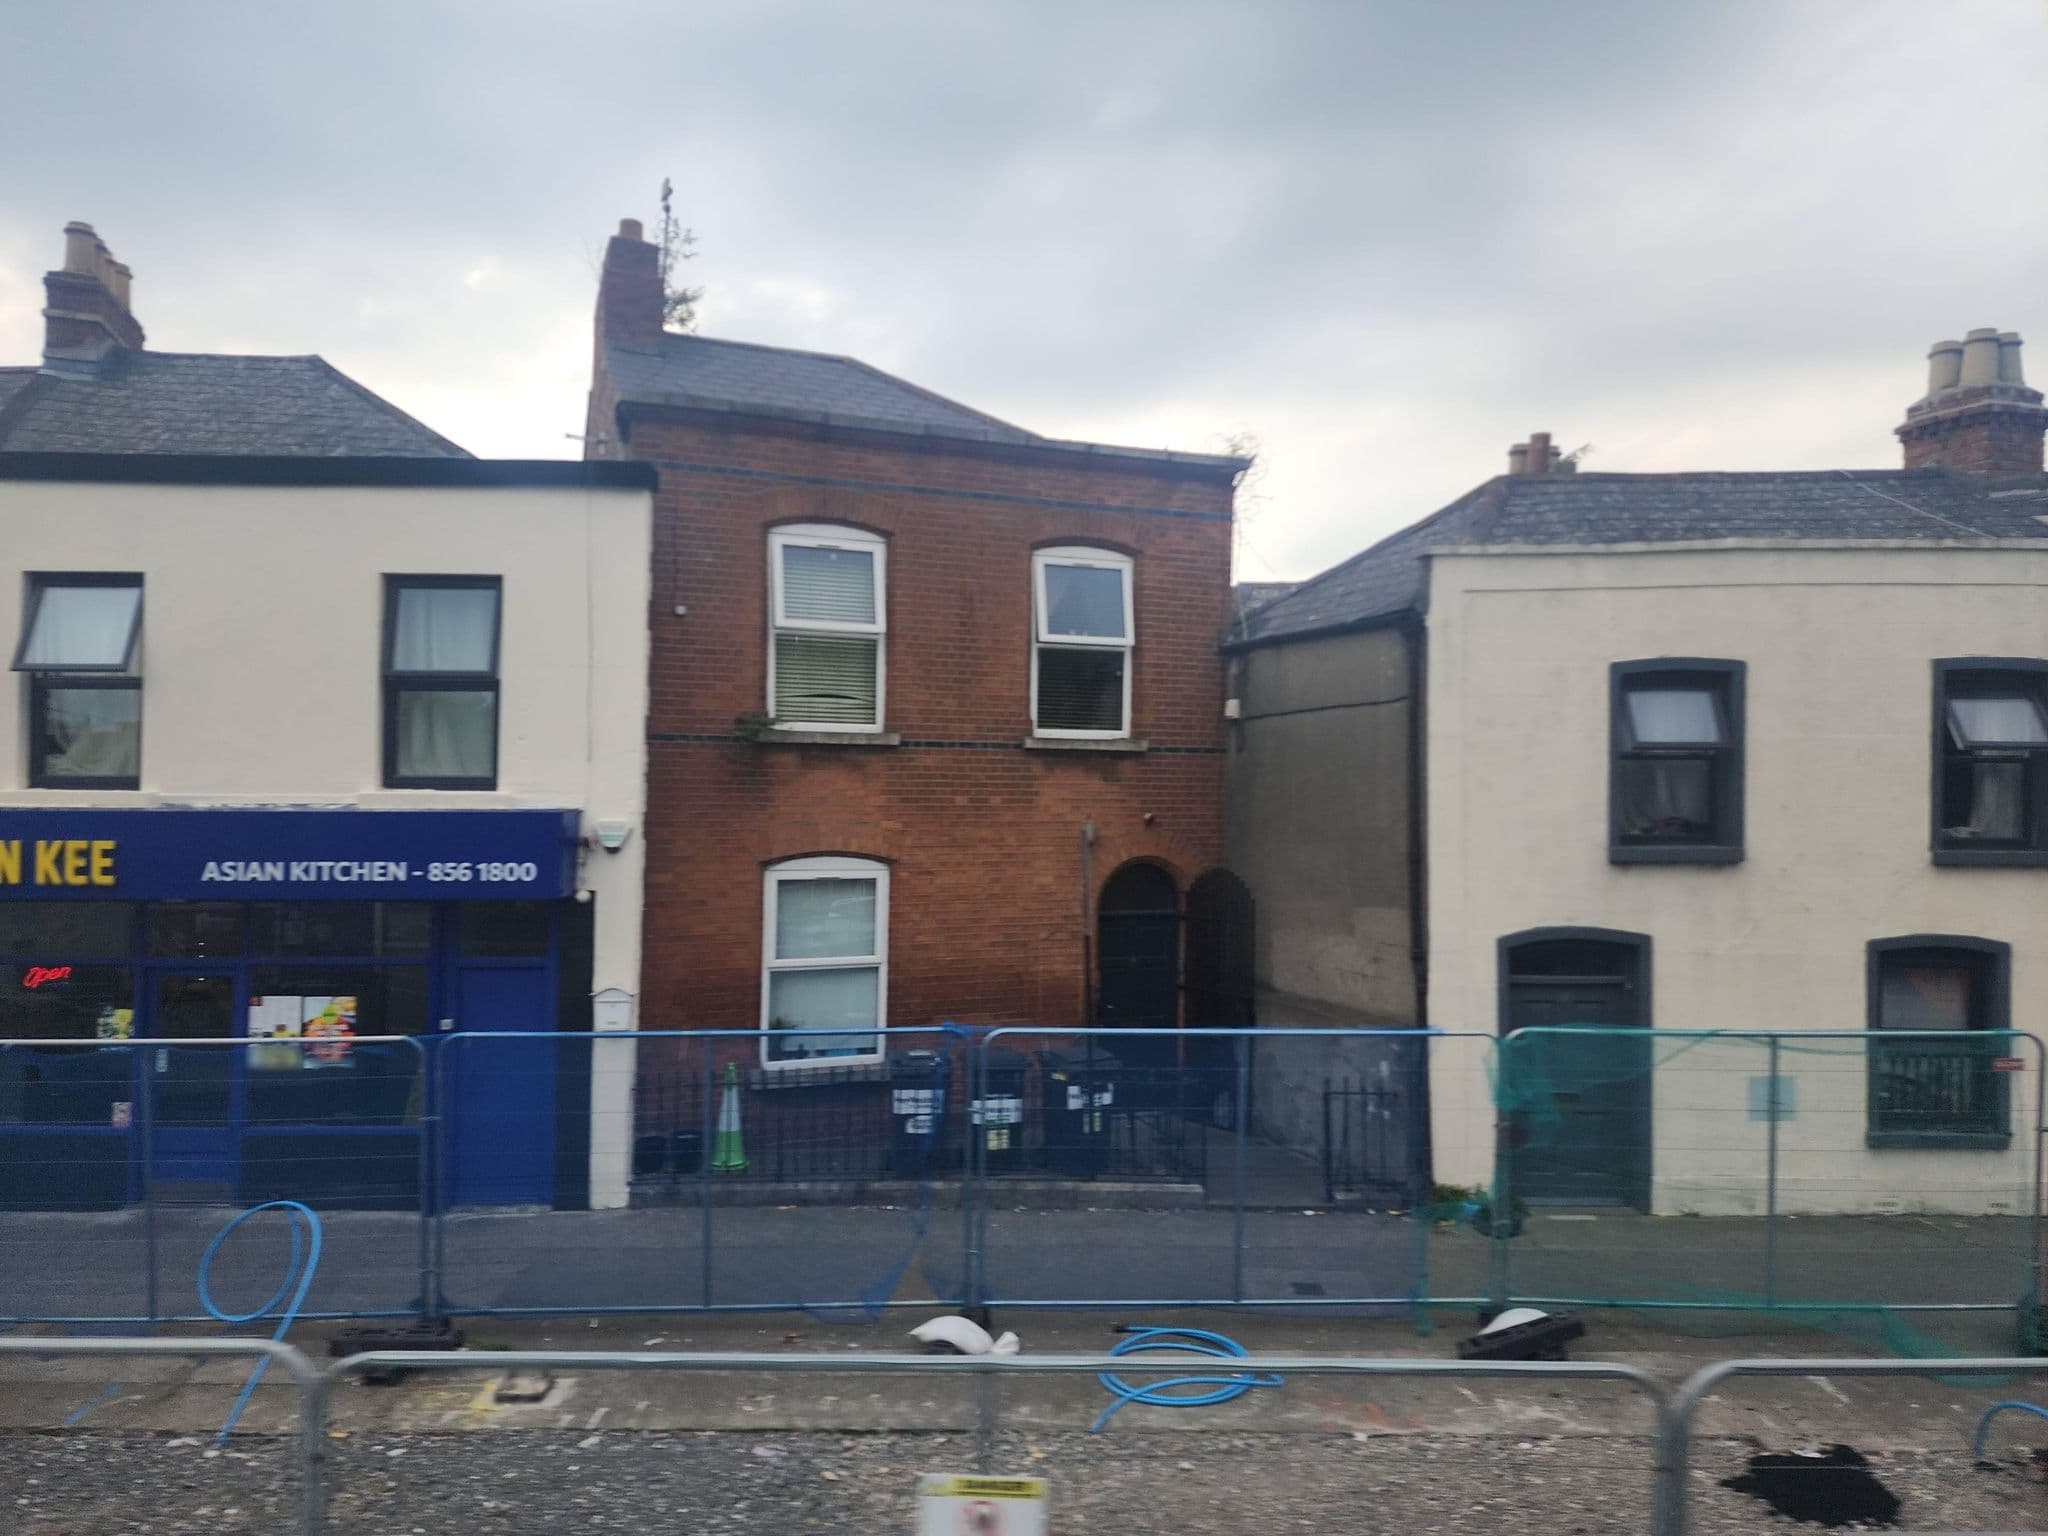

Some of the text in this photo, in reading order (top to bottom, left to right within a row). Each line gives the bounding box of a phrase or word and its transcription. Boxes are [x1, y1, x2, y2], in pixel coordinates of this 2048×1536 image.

[35, 840, 117, 886] KEE
[200, 861, 285, 882] ASIAN
[289, 861, 408, 882] KITCHEN
[427, 862, 473, 882] 856
[475, 862, 538, 882] 1800
[23, 966, 72, 988] Open
